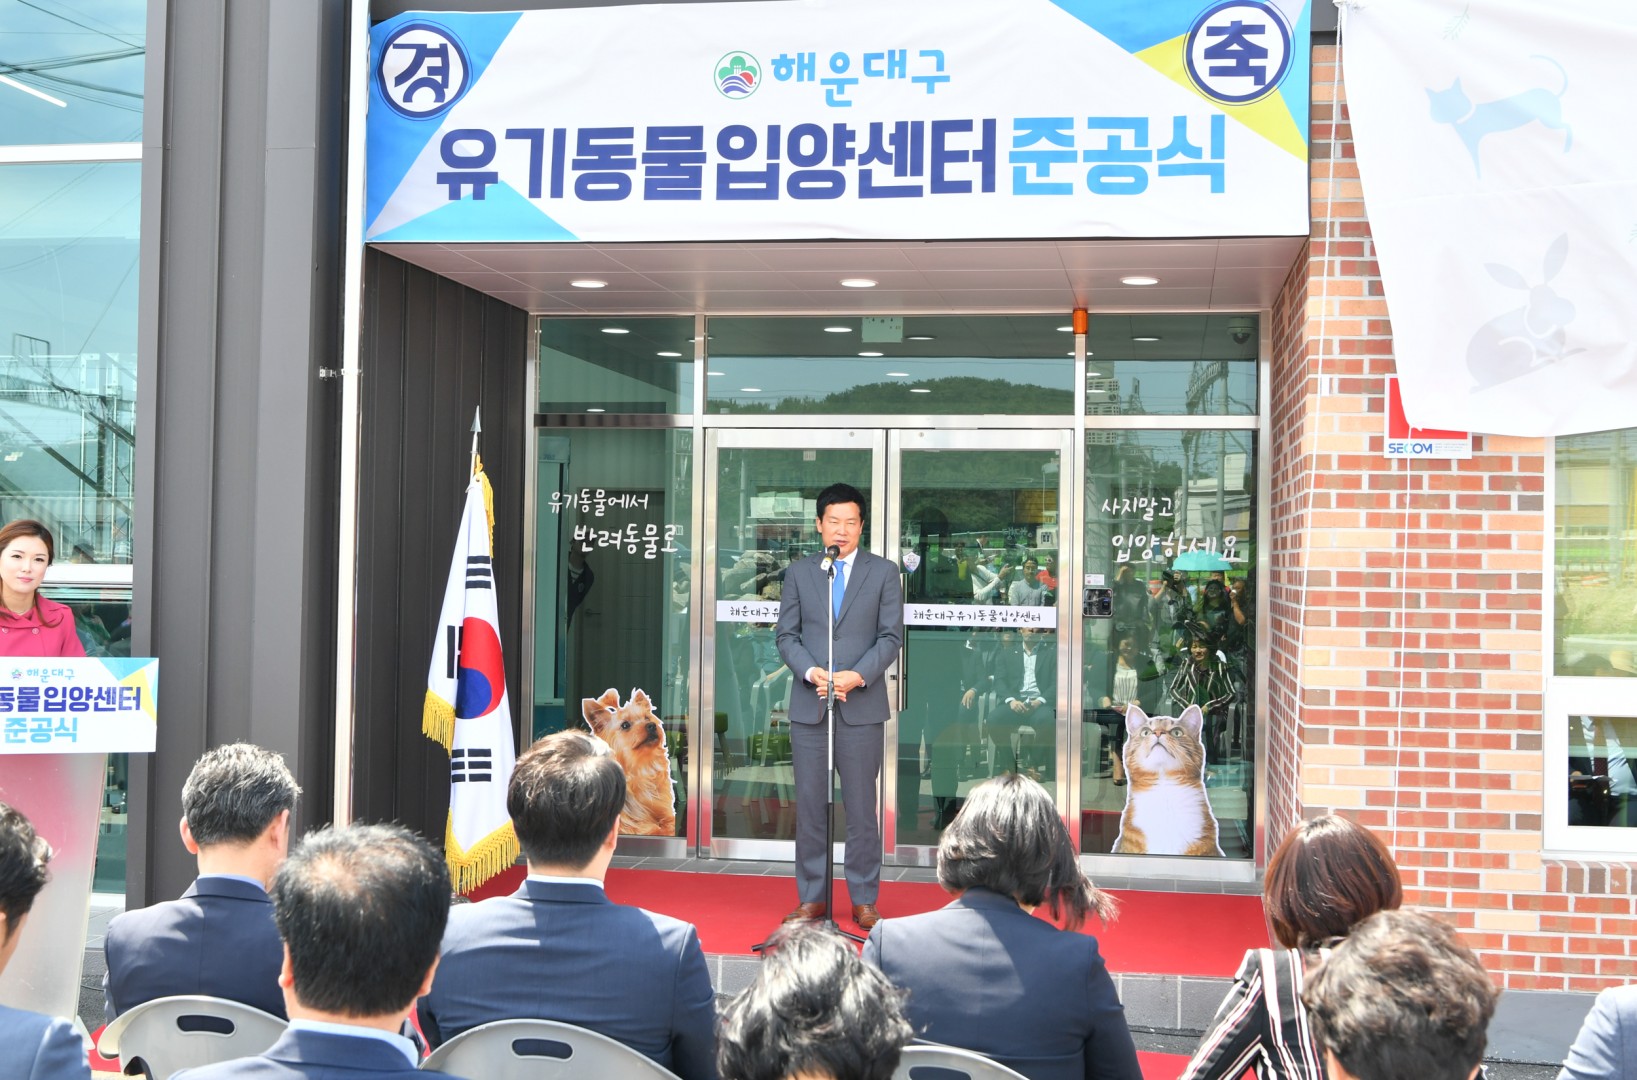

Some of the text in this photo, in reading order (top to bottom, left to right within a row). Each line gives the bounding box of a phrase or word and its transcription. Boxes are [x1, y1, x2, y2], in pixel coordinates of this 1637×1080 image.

[1203, 20, 1269, 86] 축
[392, 43, 450, 103] 경
[771, 49, 951, 107] 해운대구
[436, 114, 1226, 202] 유기동물입양센터 준공식
[1388, 443, 1433, 454] SECOM
[548, 488, 649, 517] 유기동물에서
[1101, 497, 1174, 522] 사지말고
[573, 523, 678, 559] 반려동물로
[1111, 532, 1242, 563] 입양하세요
[913, 608, 1042, 623] 해운대구유기동물입양센터
[26, 668, 75, 683] 해운대구
[4, 717, 78, 743] 준공식
